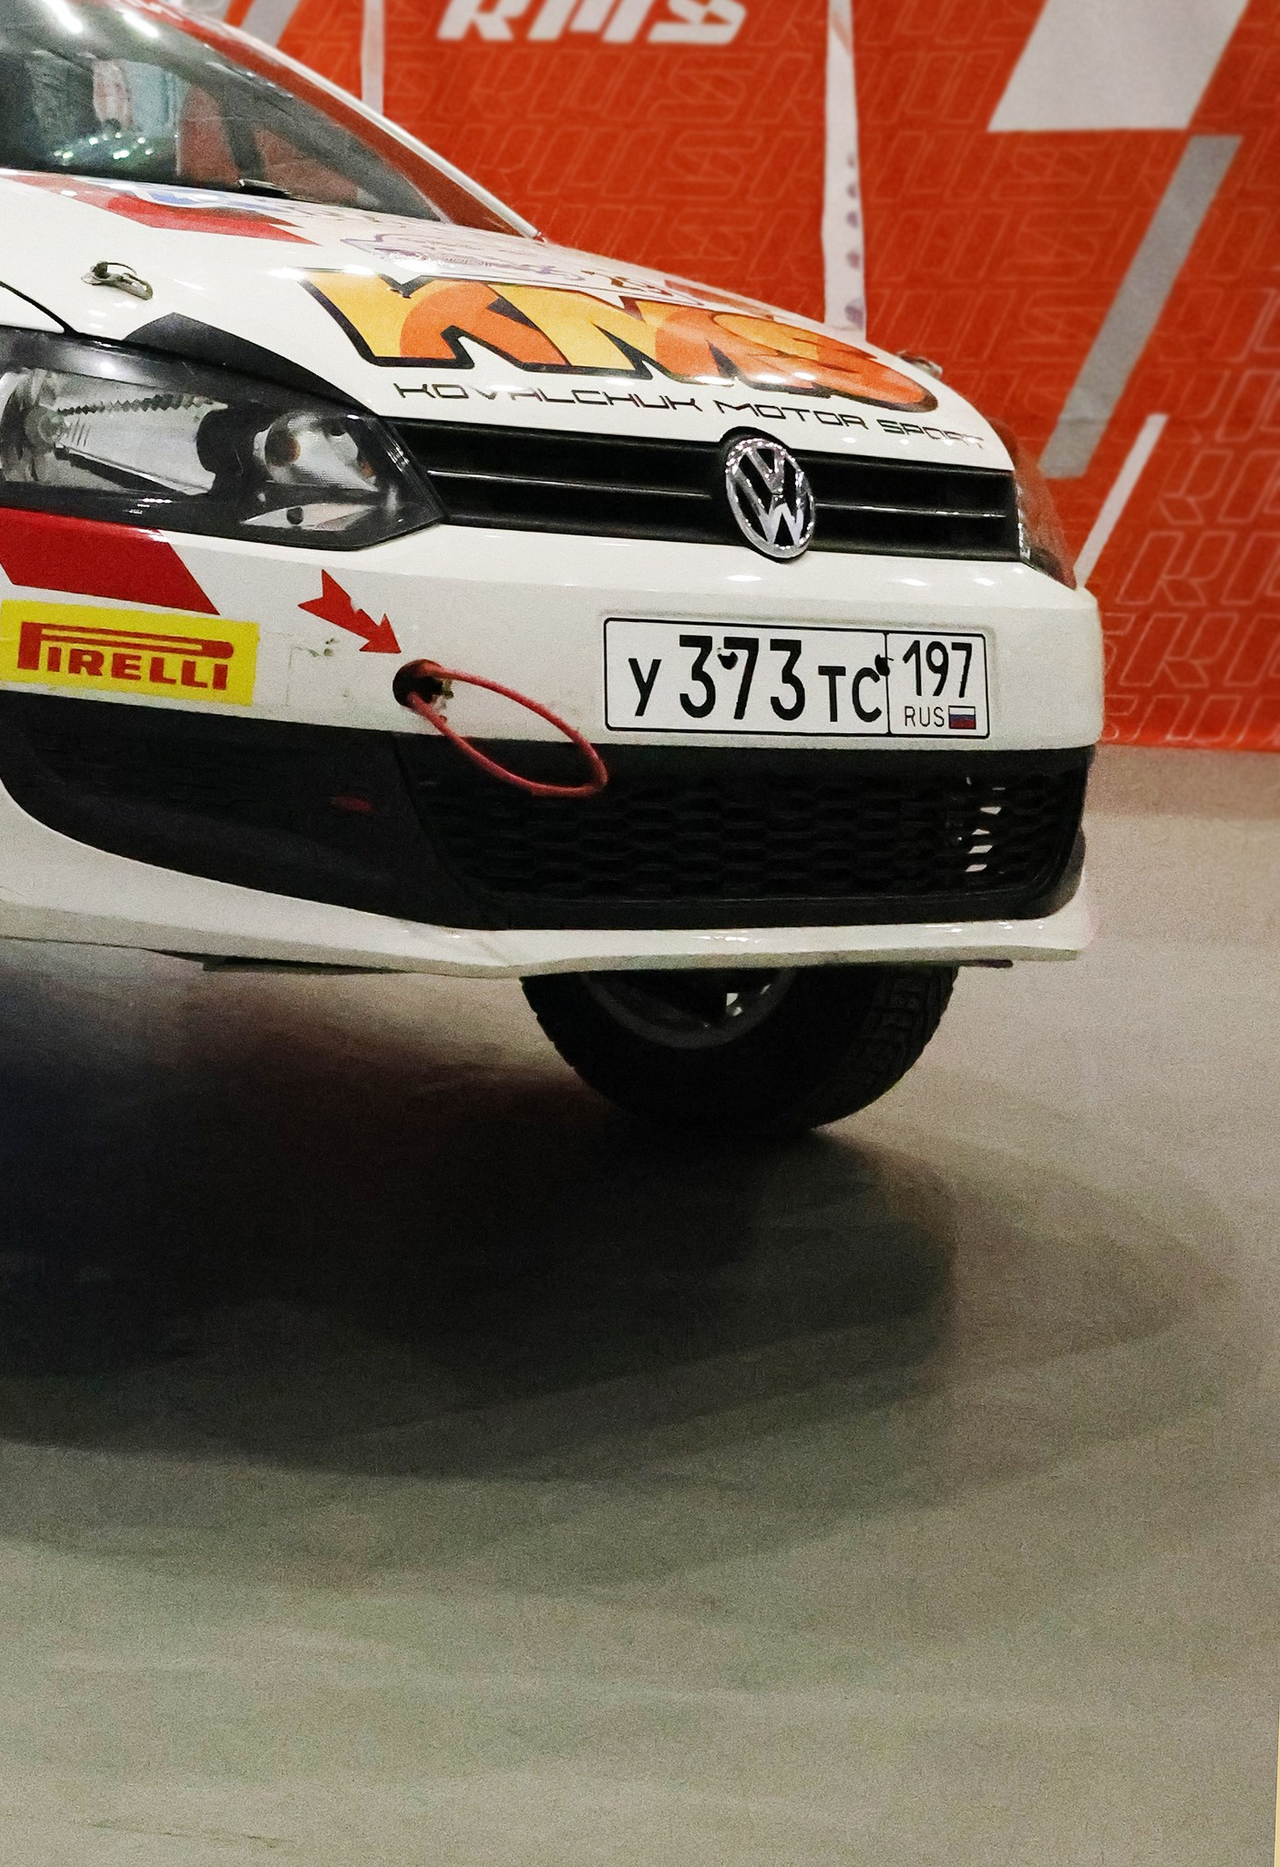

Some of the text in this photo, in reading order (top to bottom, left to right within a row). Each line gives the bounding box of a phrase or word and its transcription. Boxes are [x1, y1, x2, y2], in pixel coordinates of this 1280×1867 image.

[392, 382, 984, 450] KOVALCHUK MOTOR SPORT
[17, 621, 234, 691] PIRELLI
[902, 640, 973, 698] 197
[904, 705, 945, 727] RUS
